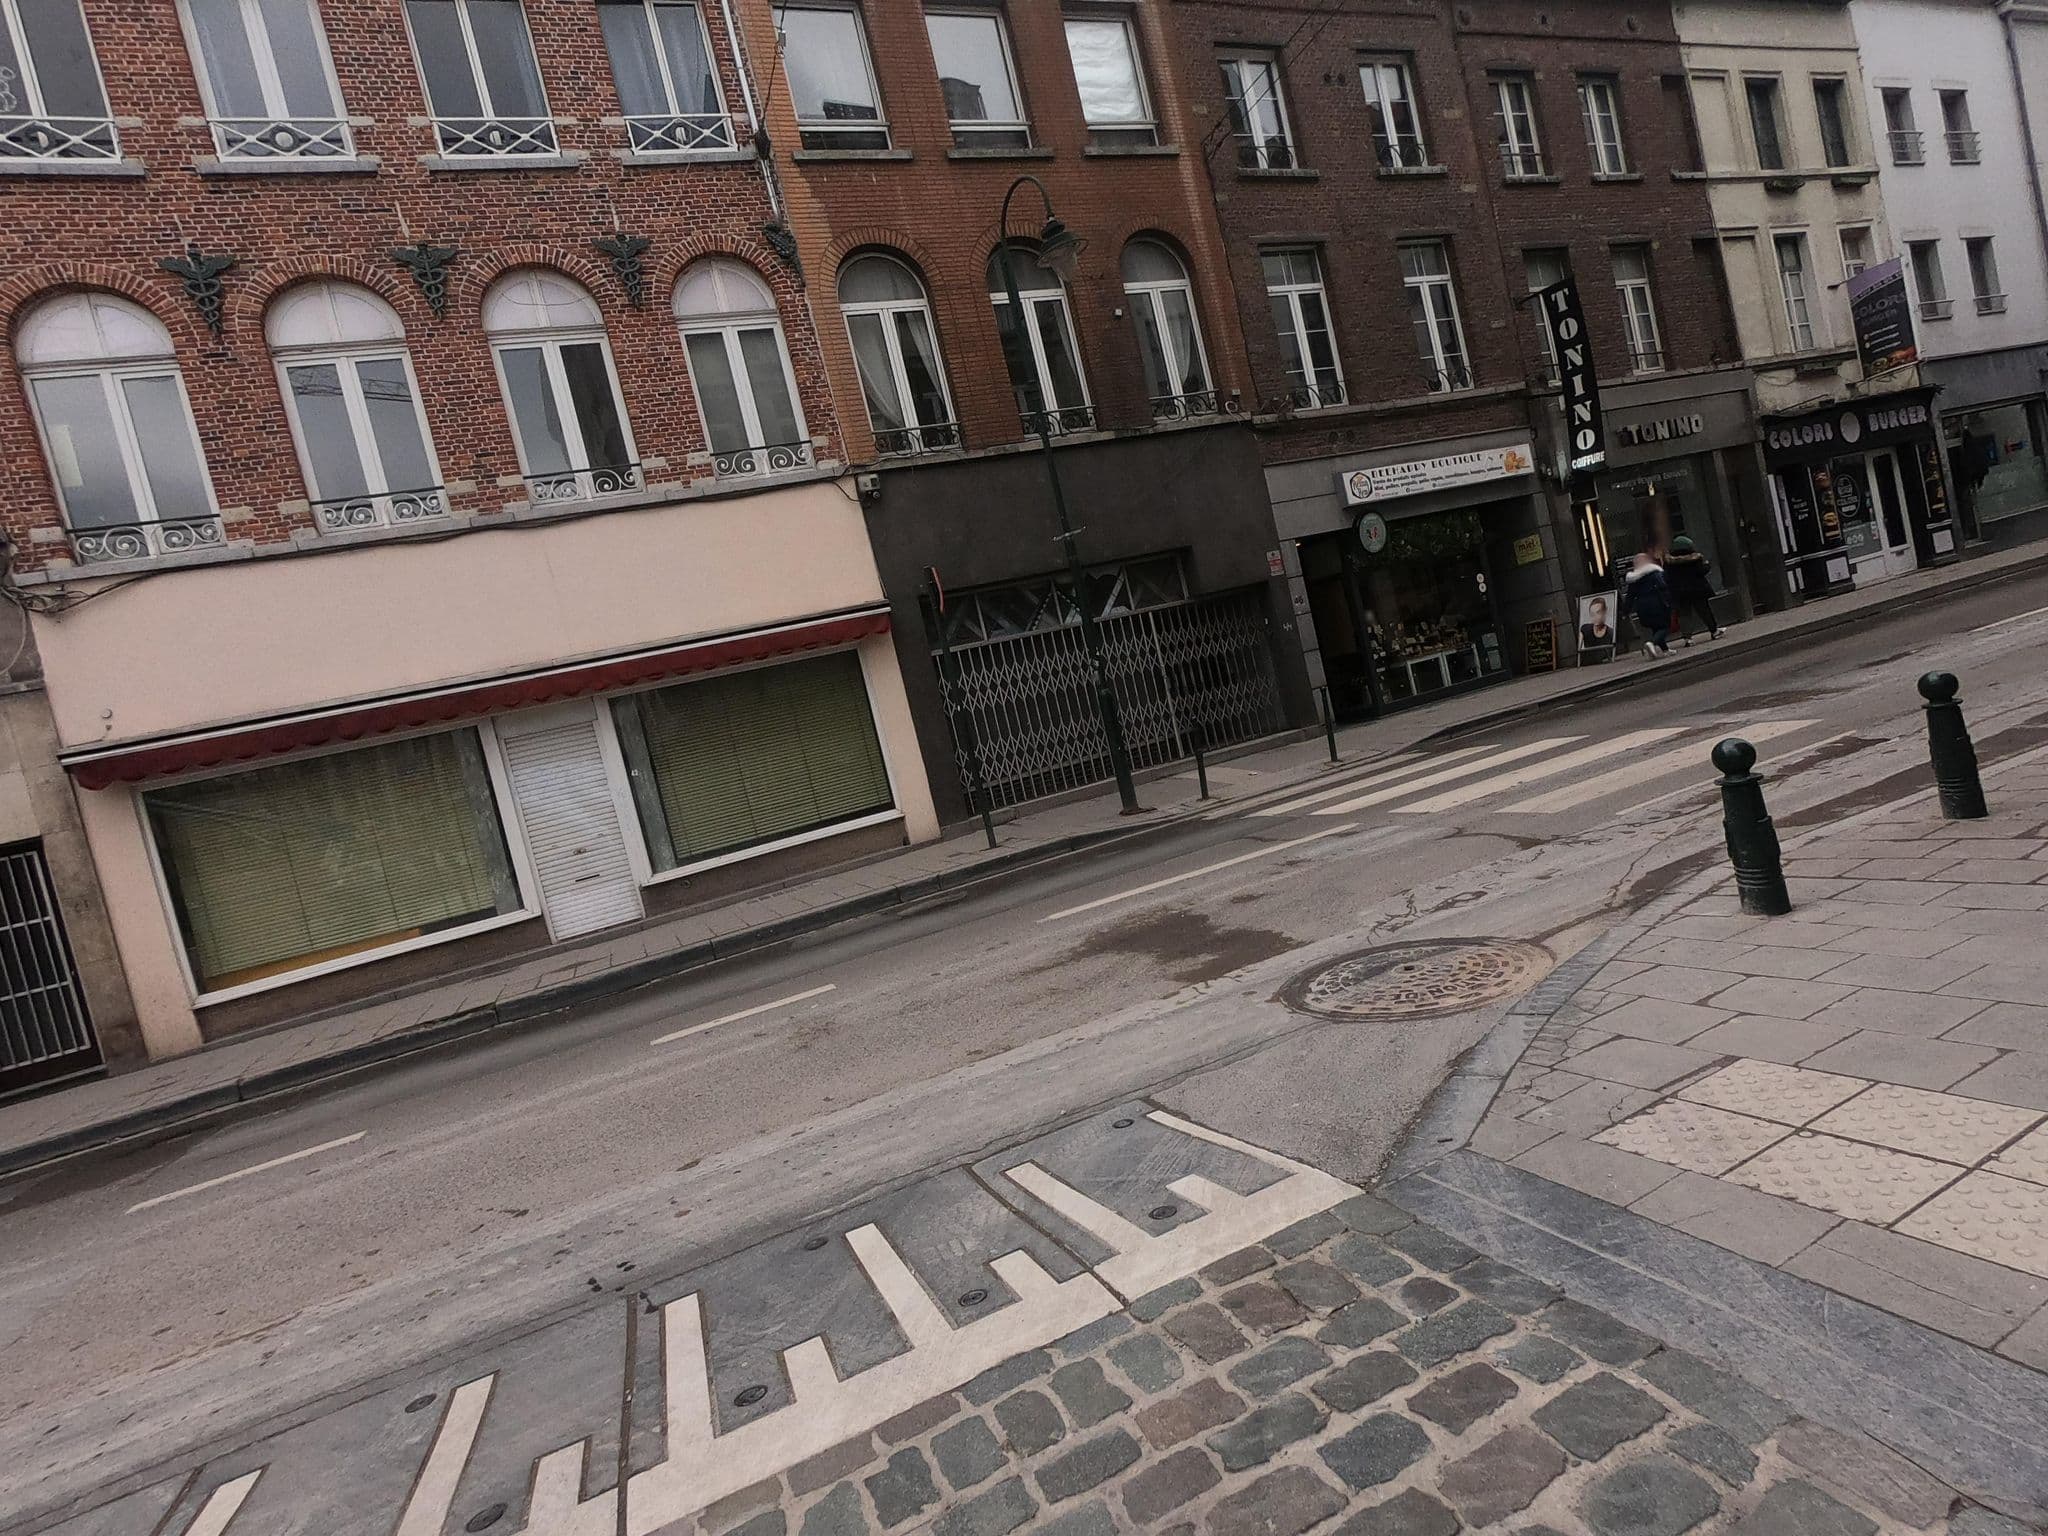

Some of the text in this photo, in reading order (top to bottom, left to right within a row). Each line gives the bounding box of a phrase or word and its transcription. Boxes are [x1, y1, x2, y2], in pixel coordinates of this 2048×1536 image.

[1551, 287, 1596, 450] TONINO
[1627, 414, 1704, 445] TONINO
[1868, 405, 1927, 432] BURGER
[1768, 421, 1834, 450] COLORS
